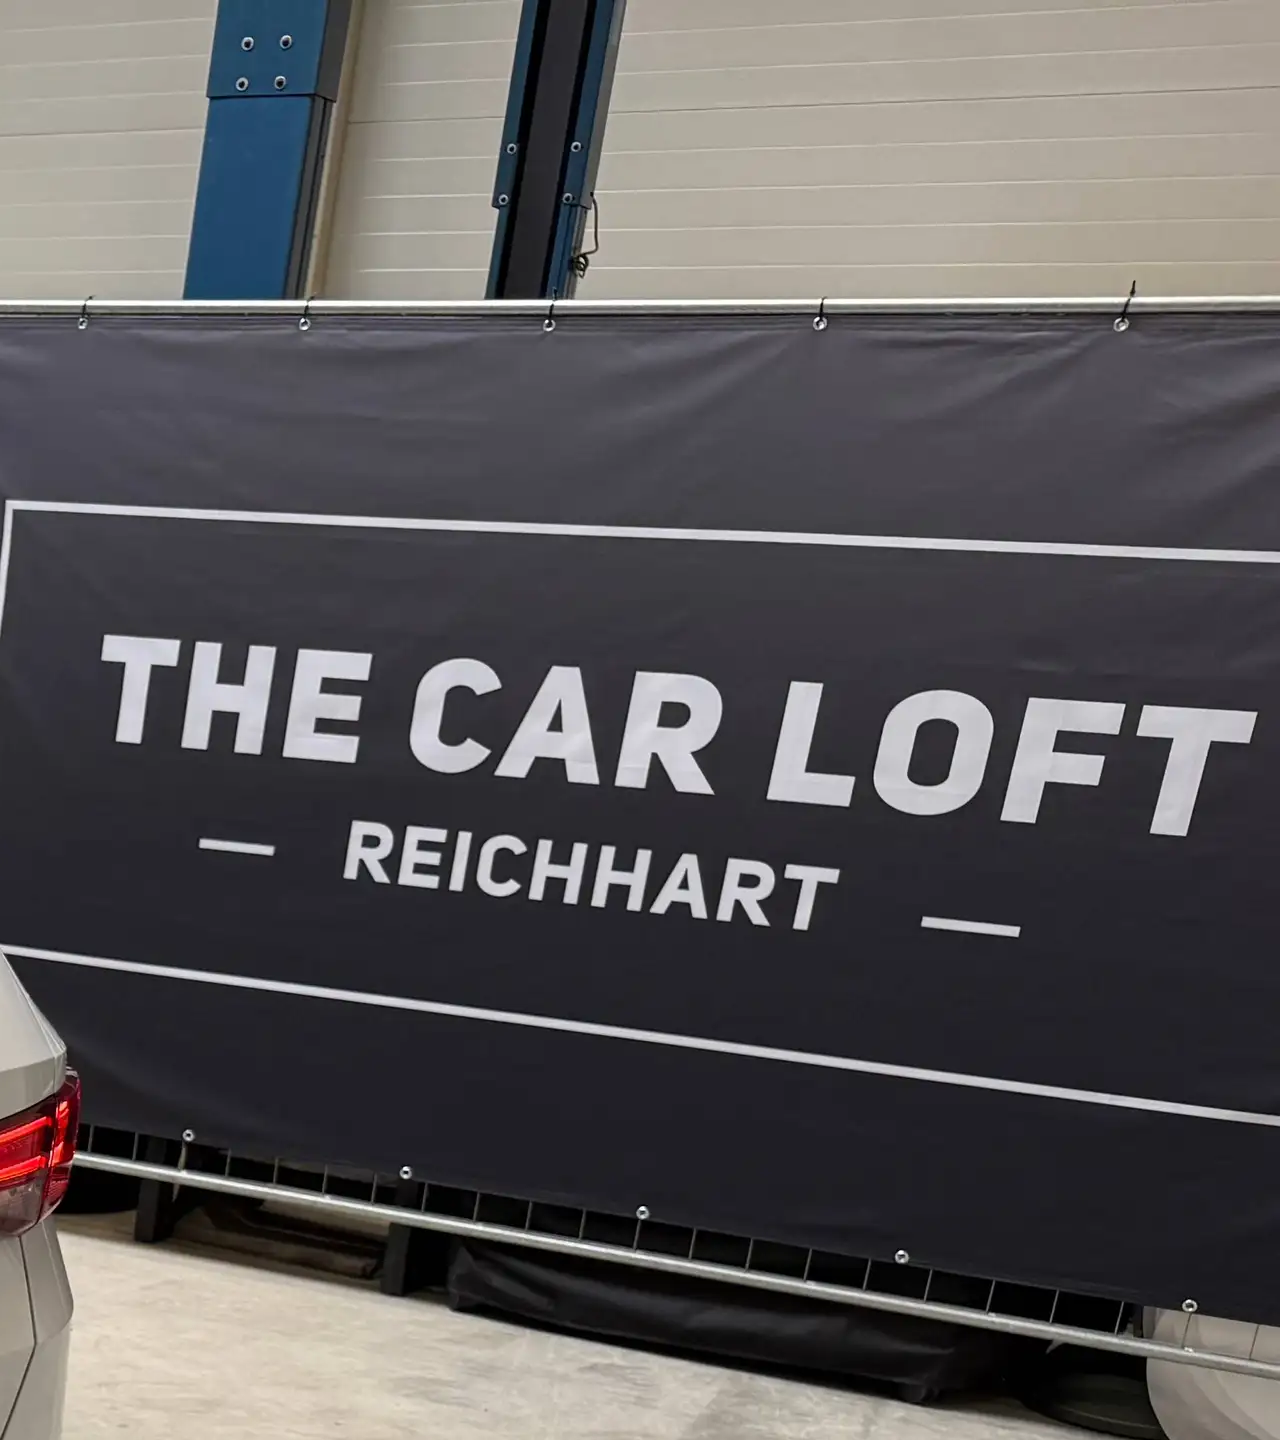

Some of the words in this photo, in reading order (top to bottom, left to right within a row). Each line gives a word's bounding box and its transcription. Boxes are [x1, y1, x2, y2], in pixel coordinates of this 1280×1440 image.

[99, 634, 374, 764] THE
[409, 657, 724, 796] CAR
[765, 680, 1259, 837] LOFT
[342, 819, 842, 932] REICHHART
